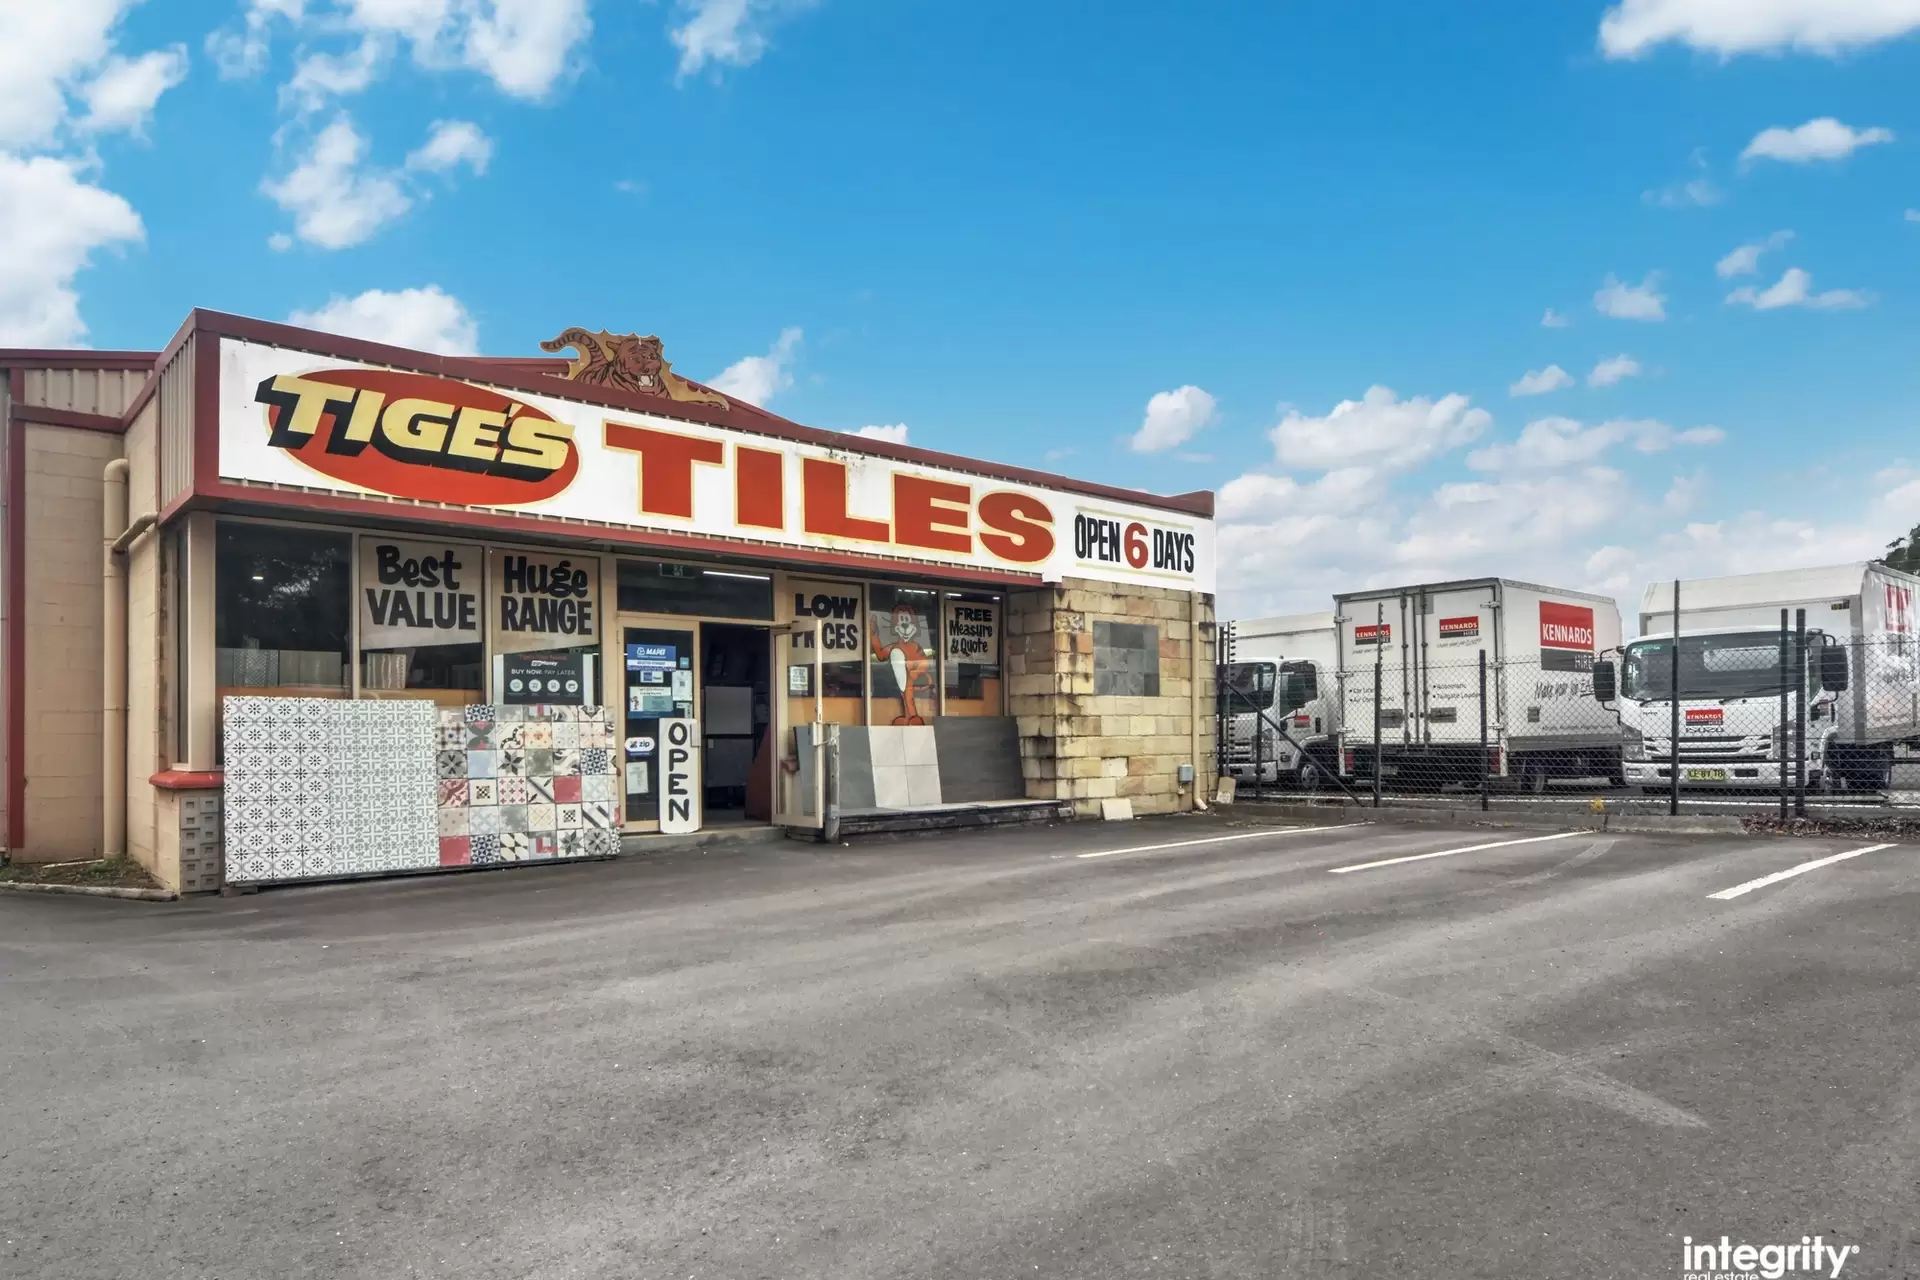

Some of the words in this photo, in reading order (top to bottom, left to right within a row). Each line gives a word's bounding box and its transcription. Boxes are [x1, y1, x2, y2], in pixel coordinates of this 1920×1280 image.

[255, 374, 576, 481] TIGE'S
[602, 419, 1056, 564] TILES
[1074, 512, 1121, 562] OPEN
[1124, 522, 1149, 569] 6
[1153, 528, 1195, 573] DAYS
[376, 545, 462, 590] Best
[504, 555, 588, 598] Huge
[366, 588, 476, 630] VALUE
[501, 596, 592, 635] RANGE
[795, 593, 858, 620] LOW
[955, 607, 992, 622] FREE
[792, 621, 858, 651] PRCES
[949, 619, 992, 638] Measure
[1356, 629, 1390, 638] KENNADS
[1440, 621, 1478, 631] KENNARDS
[1542, 623, 1592, 645] KENNARDS
[950, 638, 959, 654] &
[960, 637, 988, 657] Quote
[1574, 654, 1593, 670] HIRE
[639, 740, 650, 748] zip
[668, 722, 689, 822] OPEN
